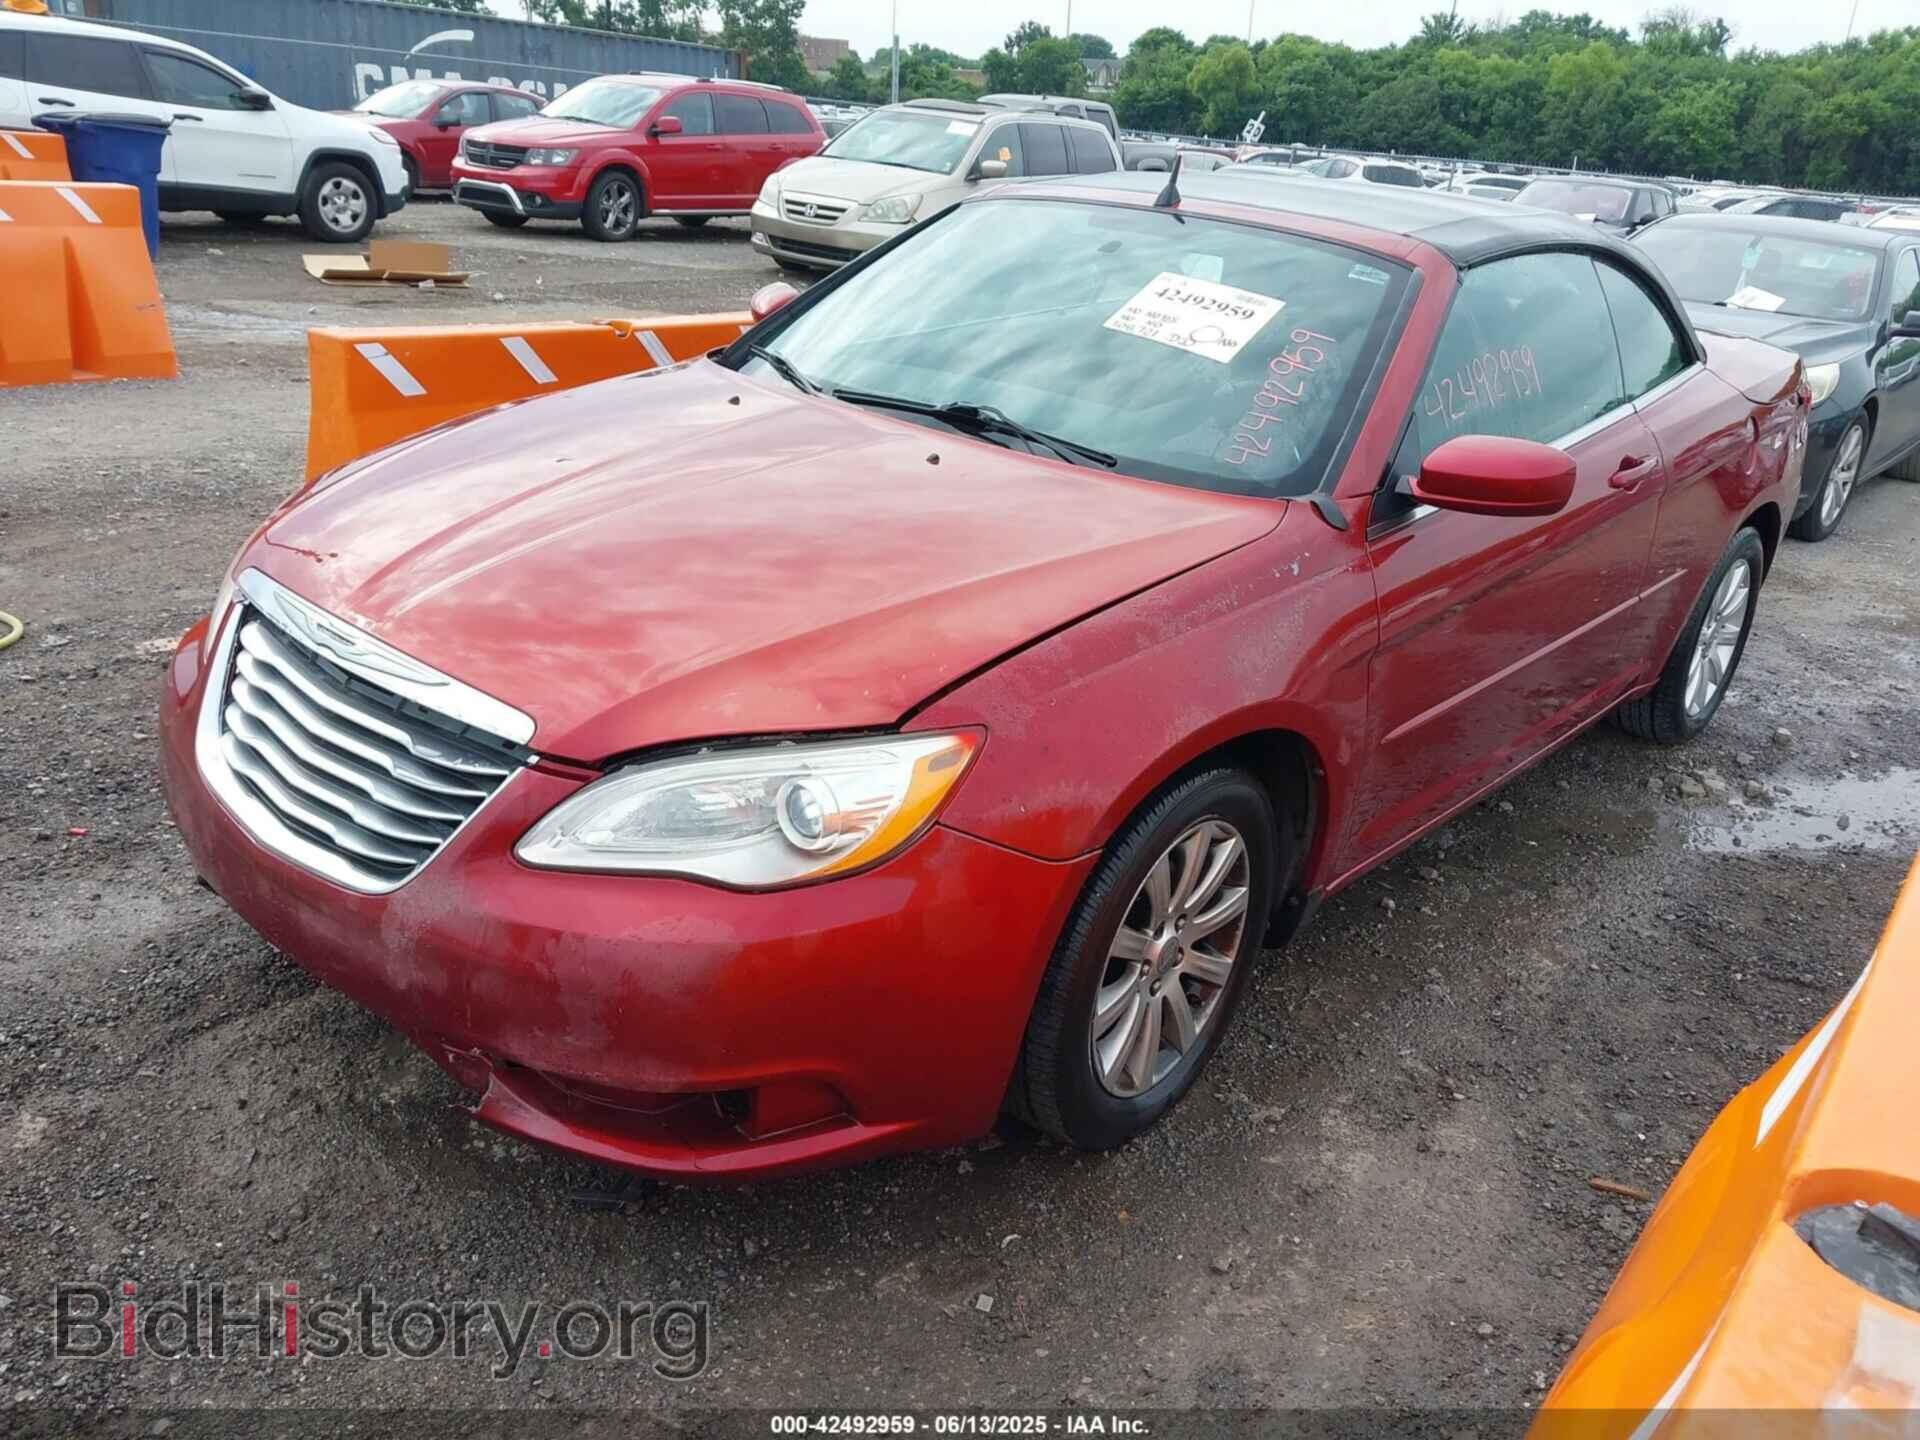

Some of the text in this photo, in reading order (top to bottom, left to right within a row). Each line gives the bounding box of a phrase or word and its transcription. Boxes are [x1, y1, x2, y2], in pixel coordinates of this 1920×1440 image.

[1155, 287, 1255, 320] 42492959
[1224, 328, 1336, 464] 42492959
[1424, 345, 1543, 429] 42492959
